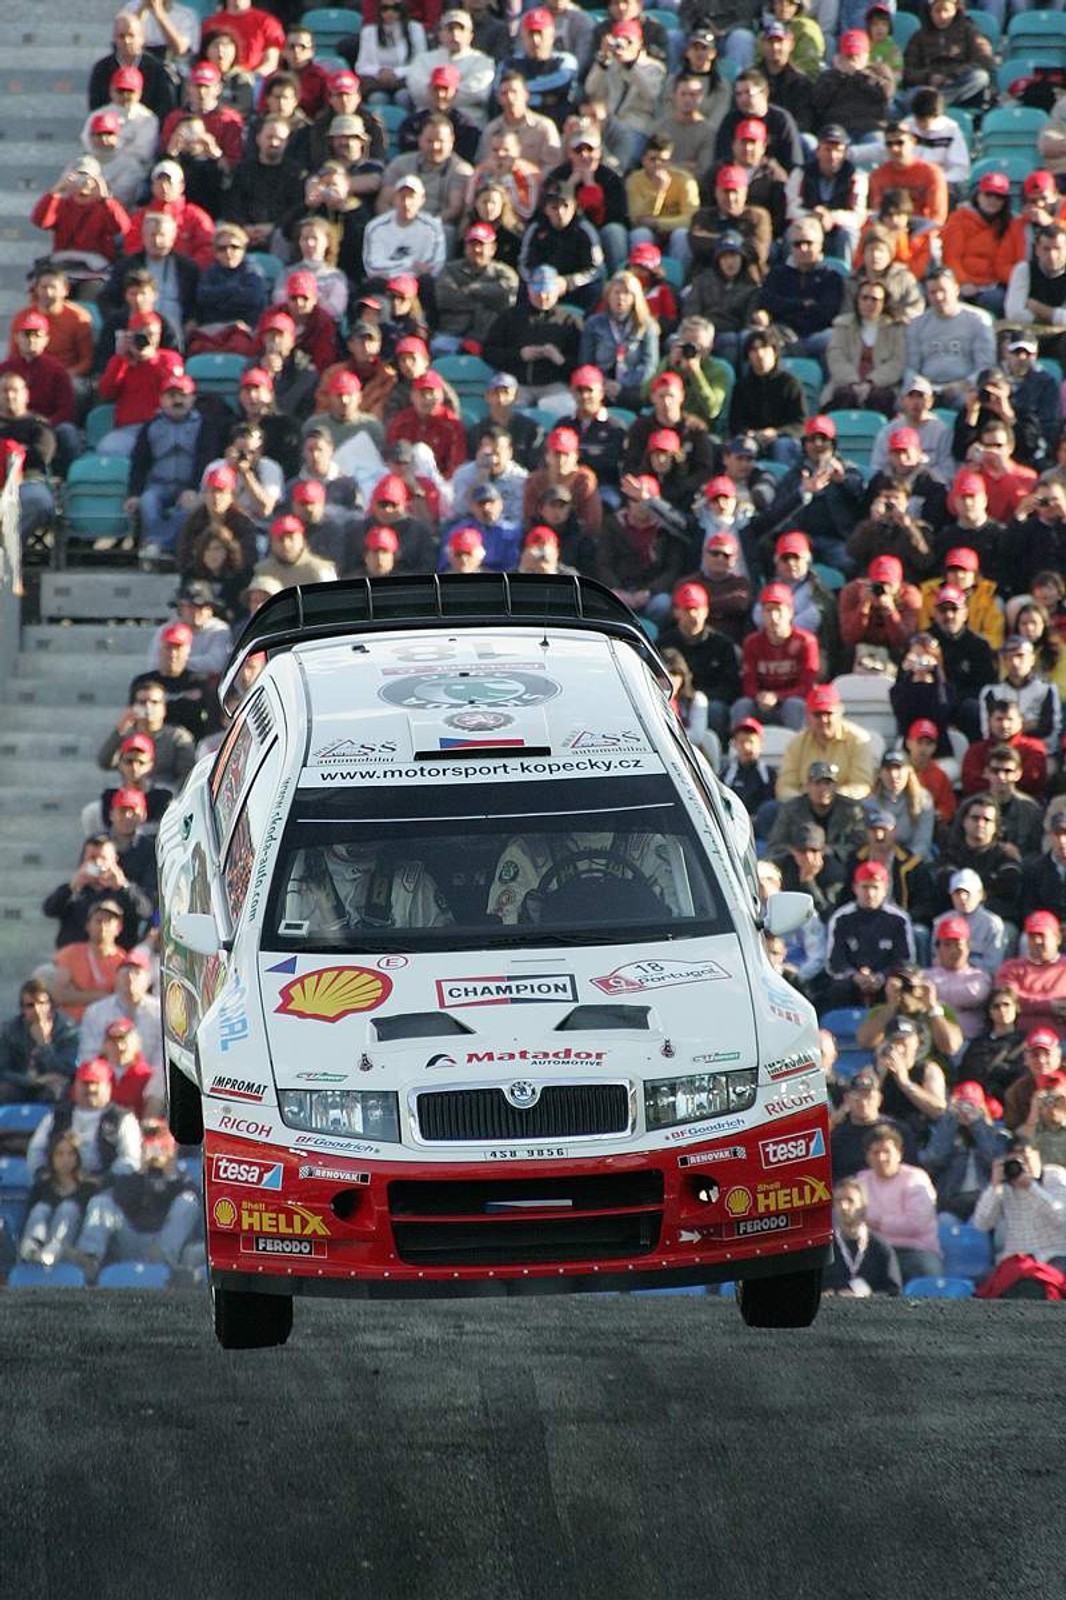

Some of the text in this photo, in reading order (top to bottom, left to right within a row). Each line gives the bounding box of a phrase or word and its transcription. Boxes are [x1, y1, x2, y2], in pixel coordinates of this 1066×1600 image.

[320, 758, 644, 781] www.motorsport-kopecky.cz
[634, 962, 664, 974] 18
[448, 983, 568, 999] CHAMPION
[466, 1048, 607, 1064] Matador
[531, 1059, 603, 1067] AUTOMOTIVE
[212, 1075, 268, 1096] IMPROMAT
[764, 1093, 816, 1116] RICOH
[219, 1115, 273, 1137] RICOH
[671, 1118, 746, 1139] BFGoodrich
[295, 1135, 375, 1152] BFGoodrich
[765, 1139, 807, 1163] tesa
[218, 1158, 260, 1183] tesa
[242, 1200, 266, 1211] Shell
[756, 1178, 832, 1213] HELIX
[242, 1206, 331, 1236] HELIX
[740, 1216, 788, 1234] FERODO
[258, 1238, 311, 1254] FERODO
